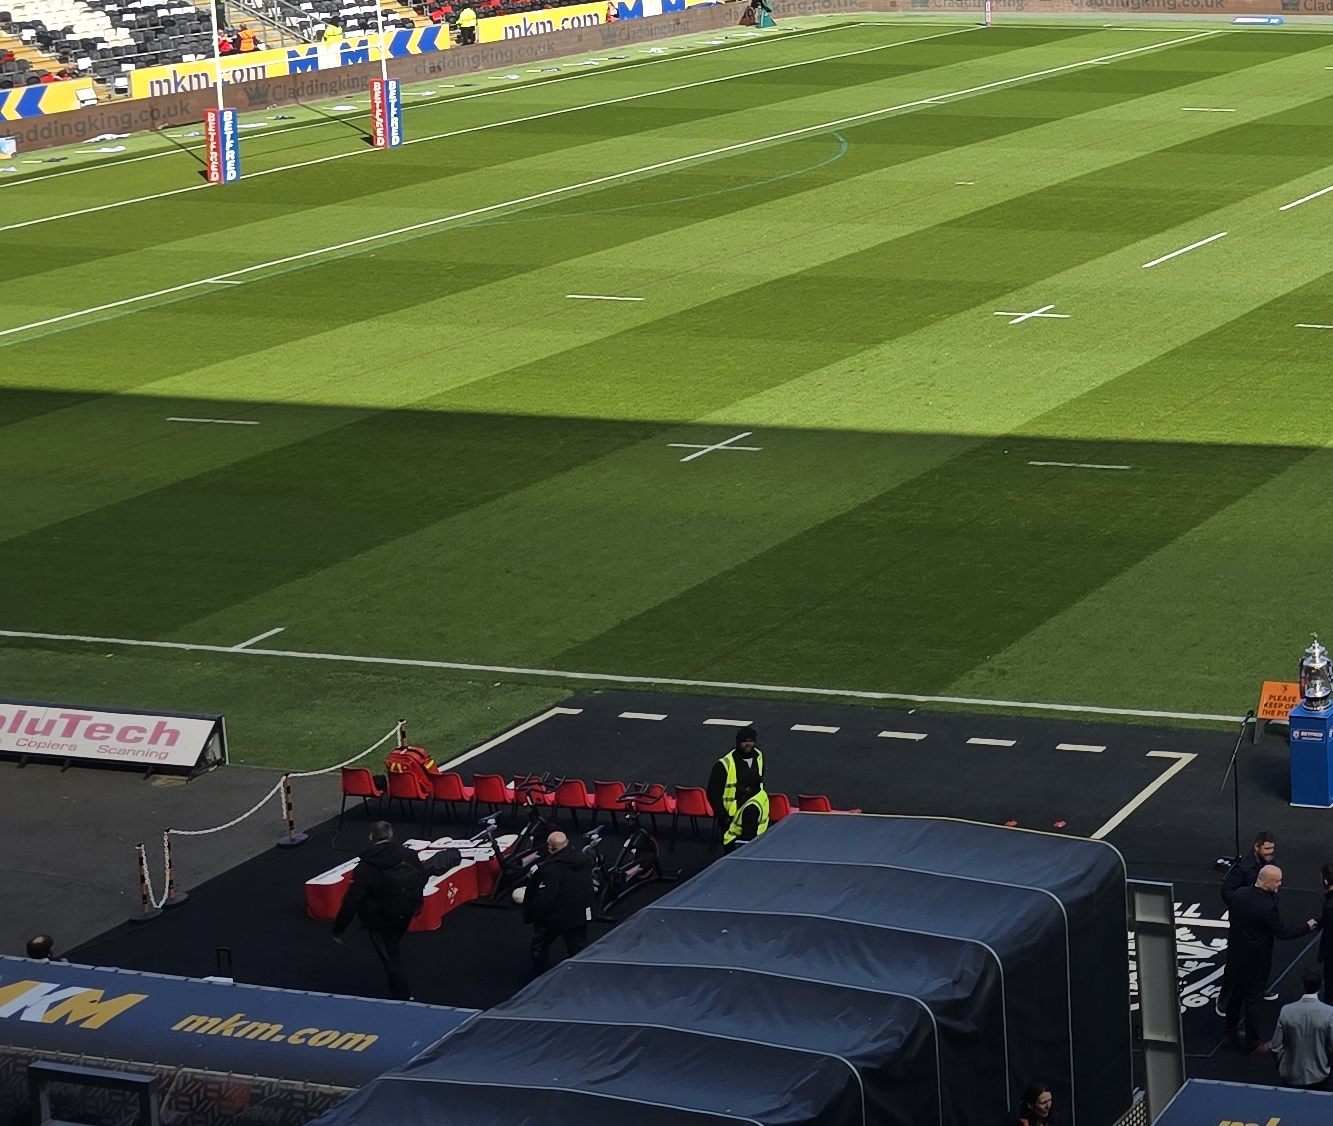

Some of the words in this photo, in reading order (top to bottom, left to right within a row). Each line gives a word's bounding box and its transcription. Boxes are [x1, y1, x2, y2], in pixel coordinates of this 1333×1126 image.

[504, 10, 600, 39] mkm.com
[415, 41, 555, 74] claddingking.co.uk
[272, 71, 370, 102] Claddingking
[374, 82, 385, 146] BETFRED
[389, 81, 400, 145] BETFRED
[207, 112, 219, 181] BETFRED
[223, 111, 237, 180] BETFRED
[1268, 694, 1297, 703] PLEASE
[0, 710, 181, 747] luTech
[15, 738, 78, 752] Copiers
[97, 744, 169, 760] Scanning
[171, 1013, 378, 1052] mkm.com
